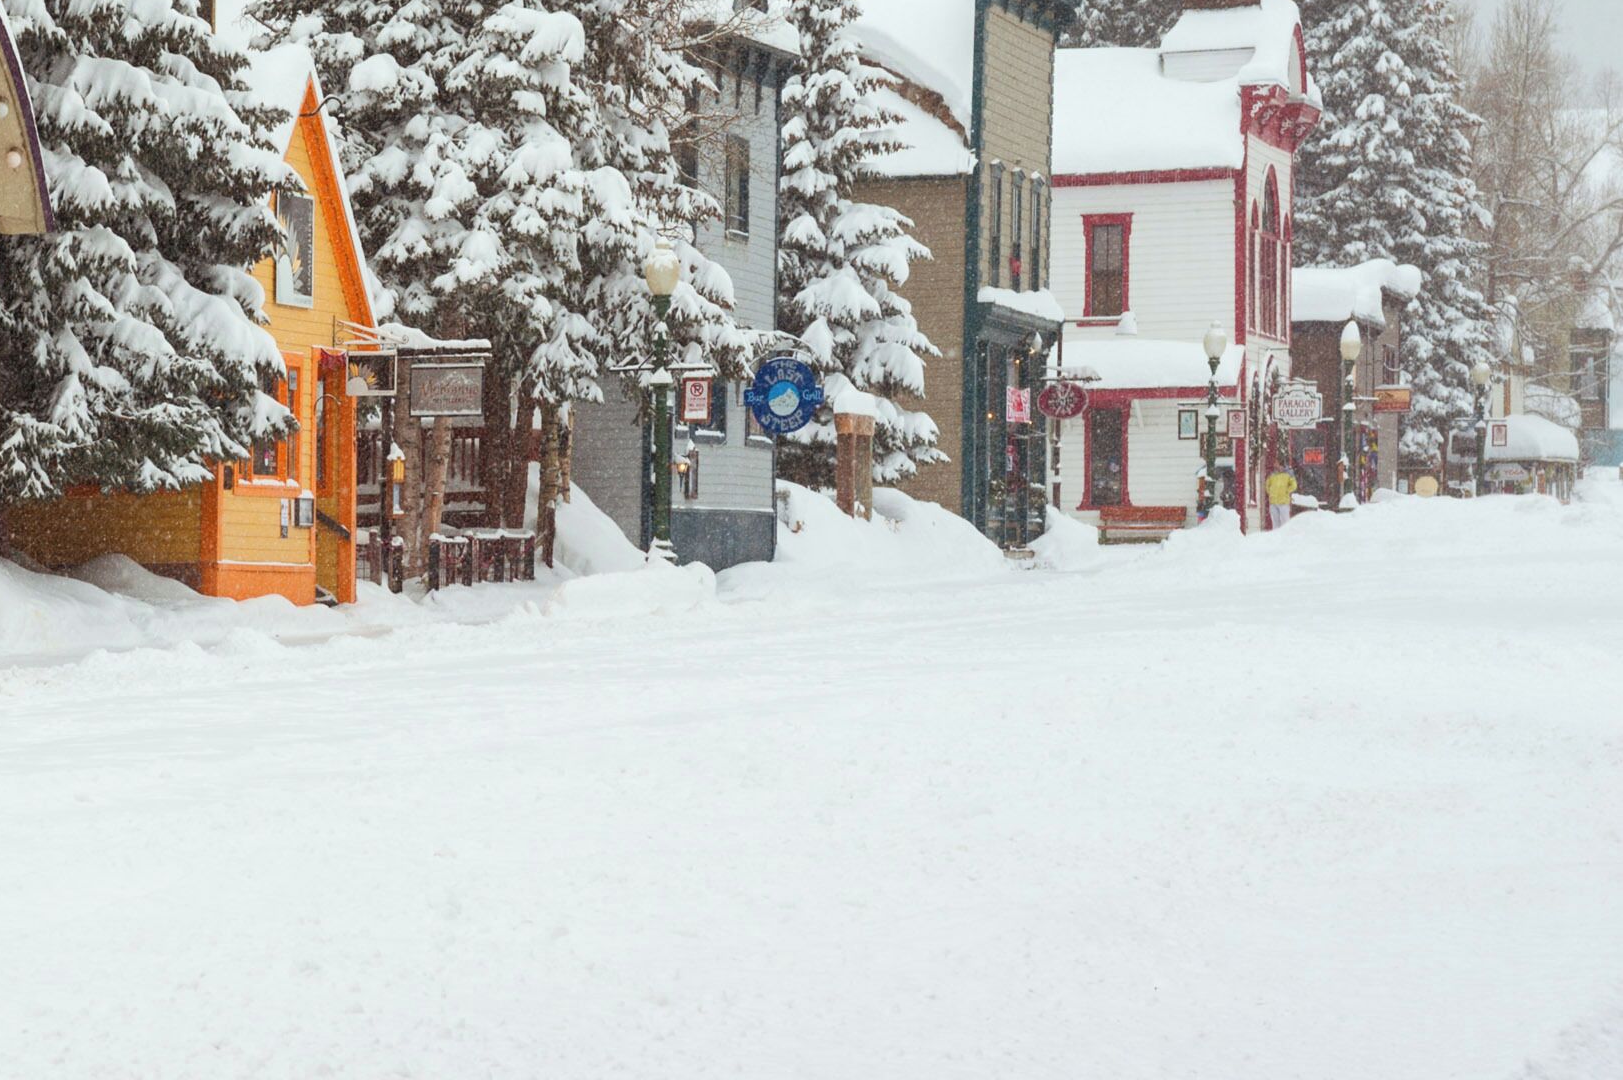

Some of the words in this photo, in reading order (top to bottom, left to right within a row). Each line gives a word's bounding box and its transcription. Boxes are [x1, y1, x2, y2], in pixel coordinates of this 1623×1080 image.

[771, 360, 797, 370] THE
[765, 369, 804, 385] LAST
[746, 391, 764, 402] Bar
[802, 389, 821, 401] Grill
[1278, 400, 1316, 408] PARAGON
[1279, 409, 1314, 418] GALLERY
[761, 410, 804, 431] STEEP
